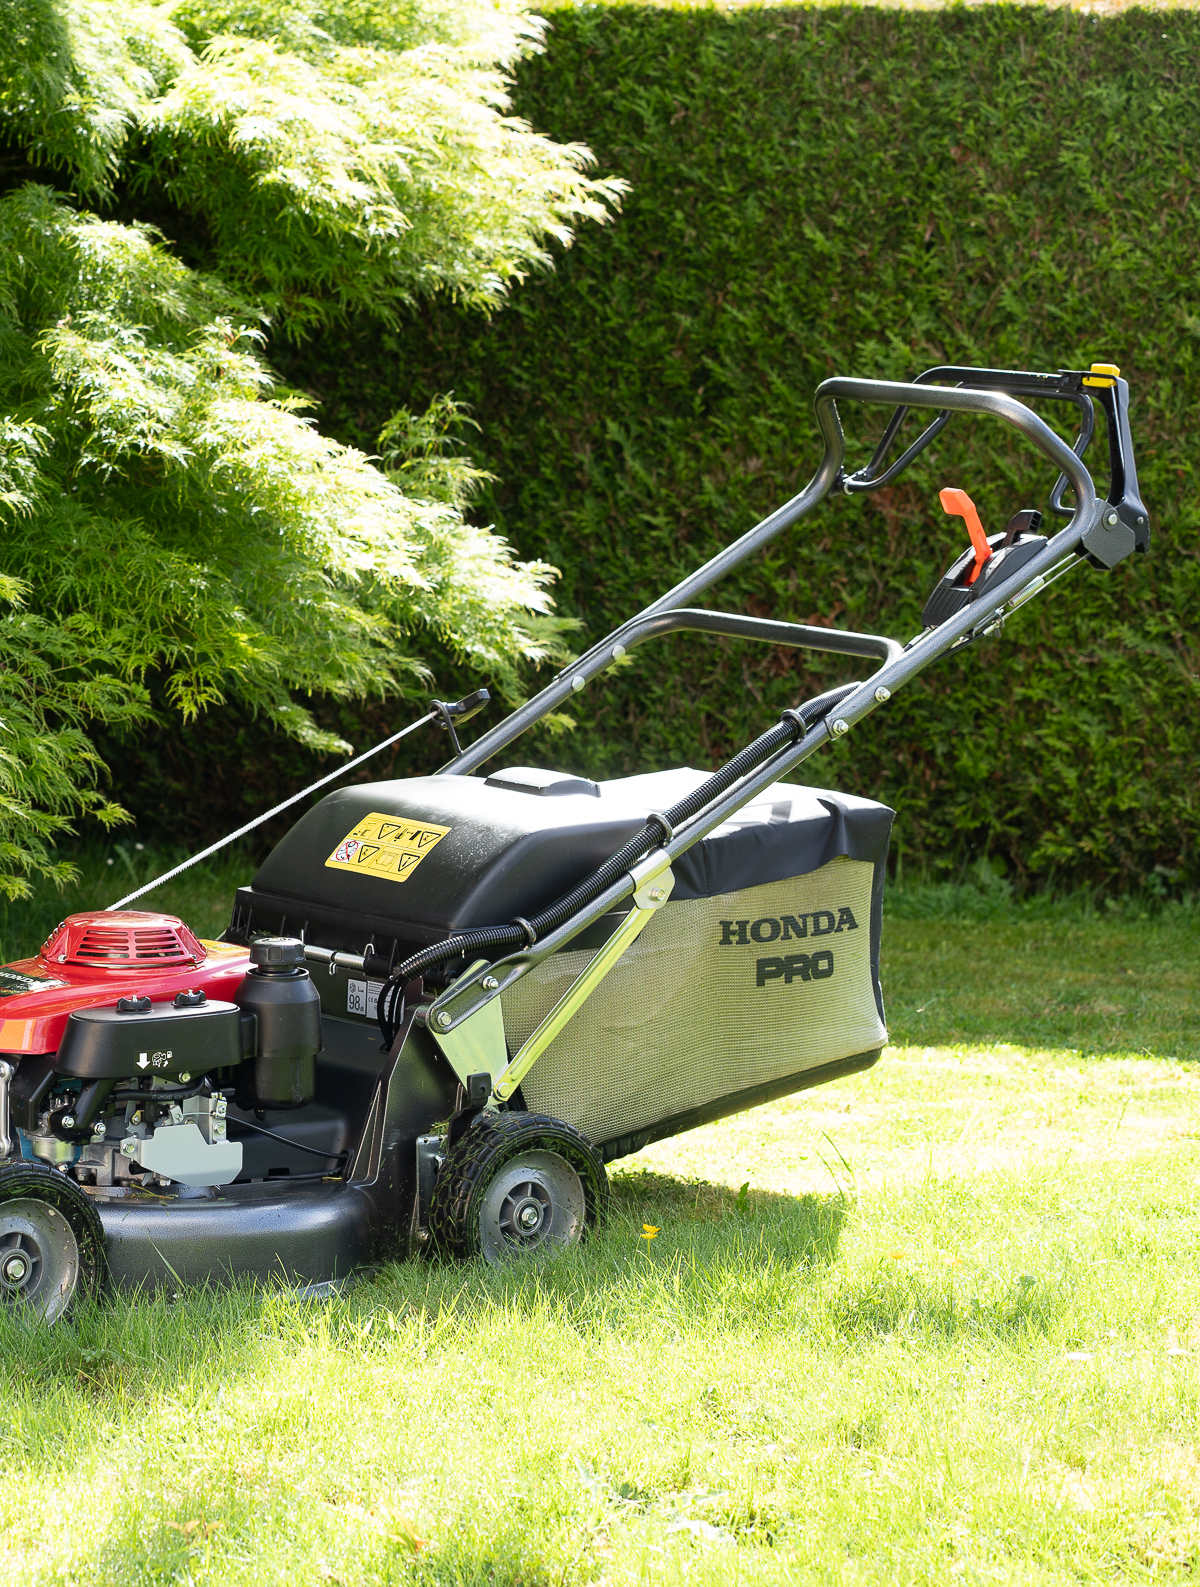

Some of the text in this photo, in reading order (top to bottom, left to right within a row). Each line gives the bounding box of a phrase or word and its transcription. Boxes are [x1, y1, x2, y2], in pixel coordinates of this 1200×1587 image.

[719, 907, 859, 945] HONDA
[756, 950, 834, 987] PRO
[349, 994, 360, 1010] 98
